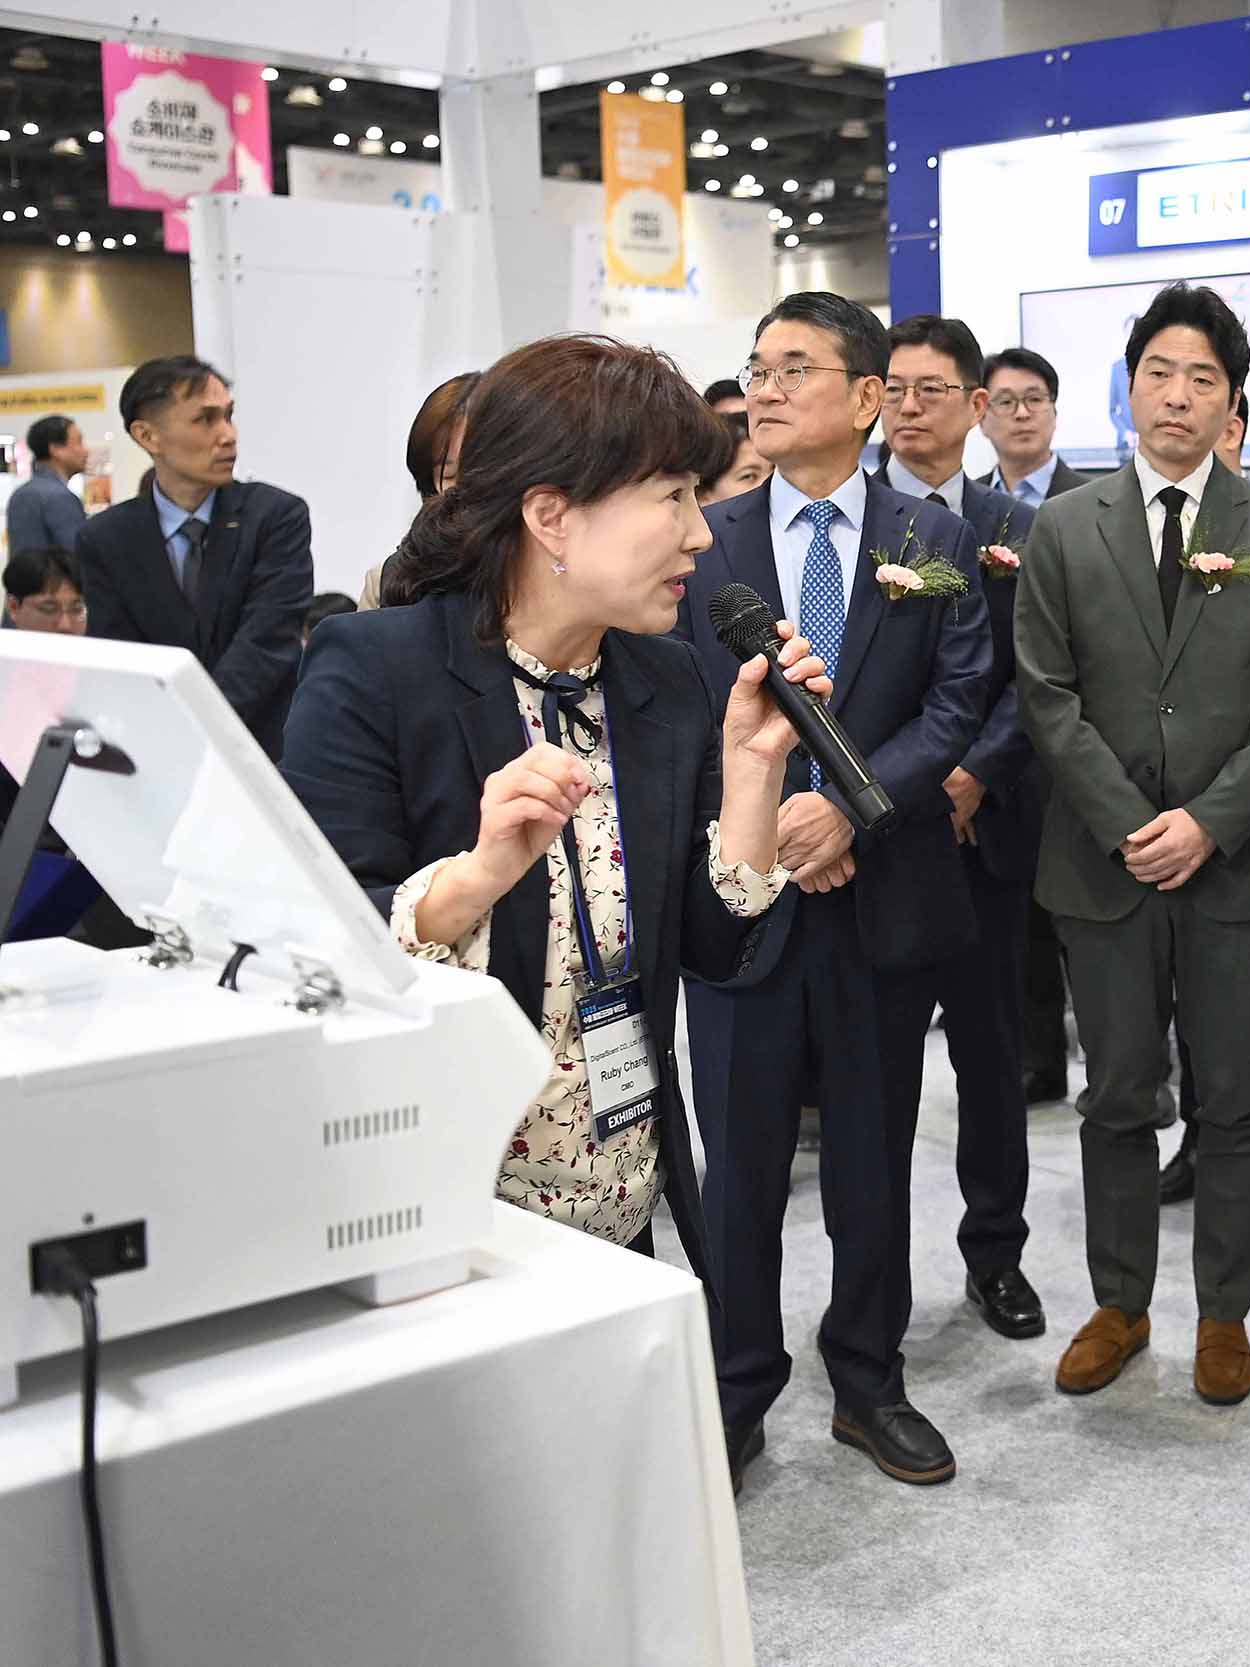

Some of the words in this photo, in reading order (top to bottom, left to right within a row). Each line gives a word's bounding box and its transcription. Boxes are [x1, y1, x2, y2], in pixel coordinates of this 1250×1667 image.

[1099, 198, 1126, 226] 07
[600, 1068, 622, 1082] Ruby
[623, 1055, 649, 1073] Chang
[607, 1099, 653, 1129] EXHIBITOR
